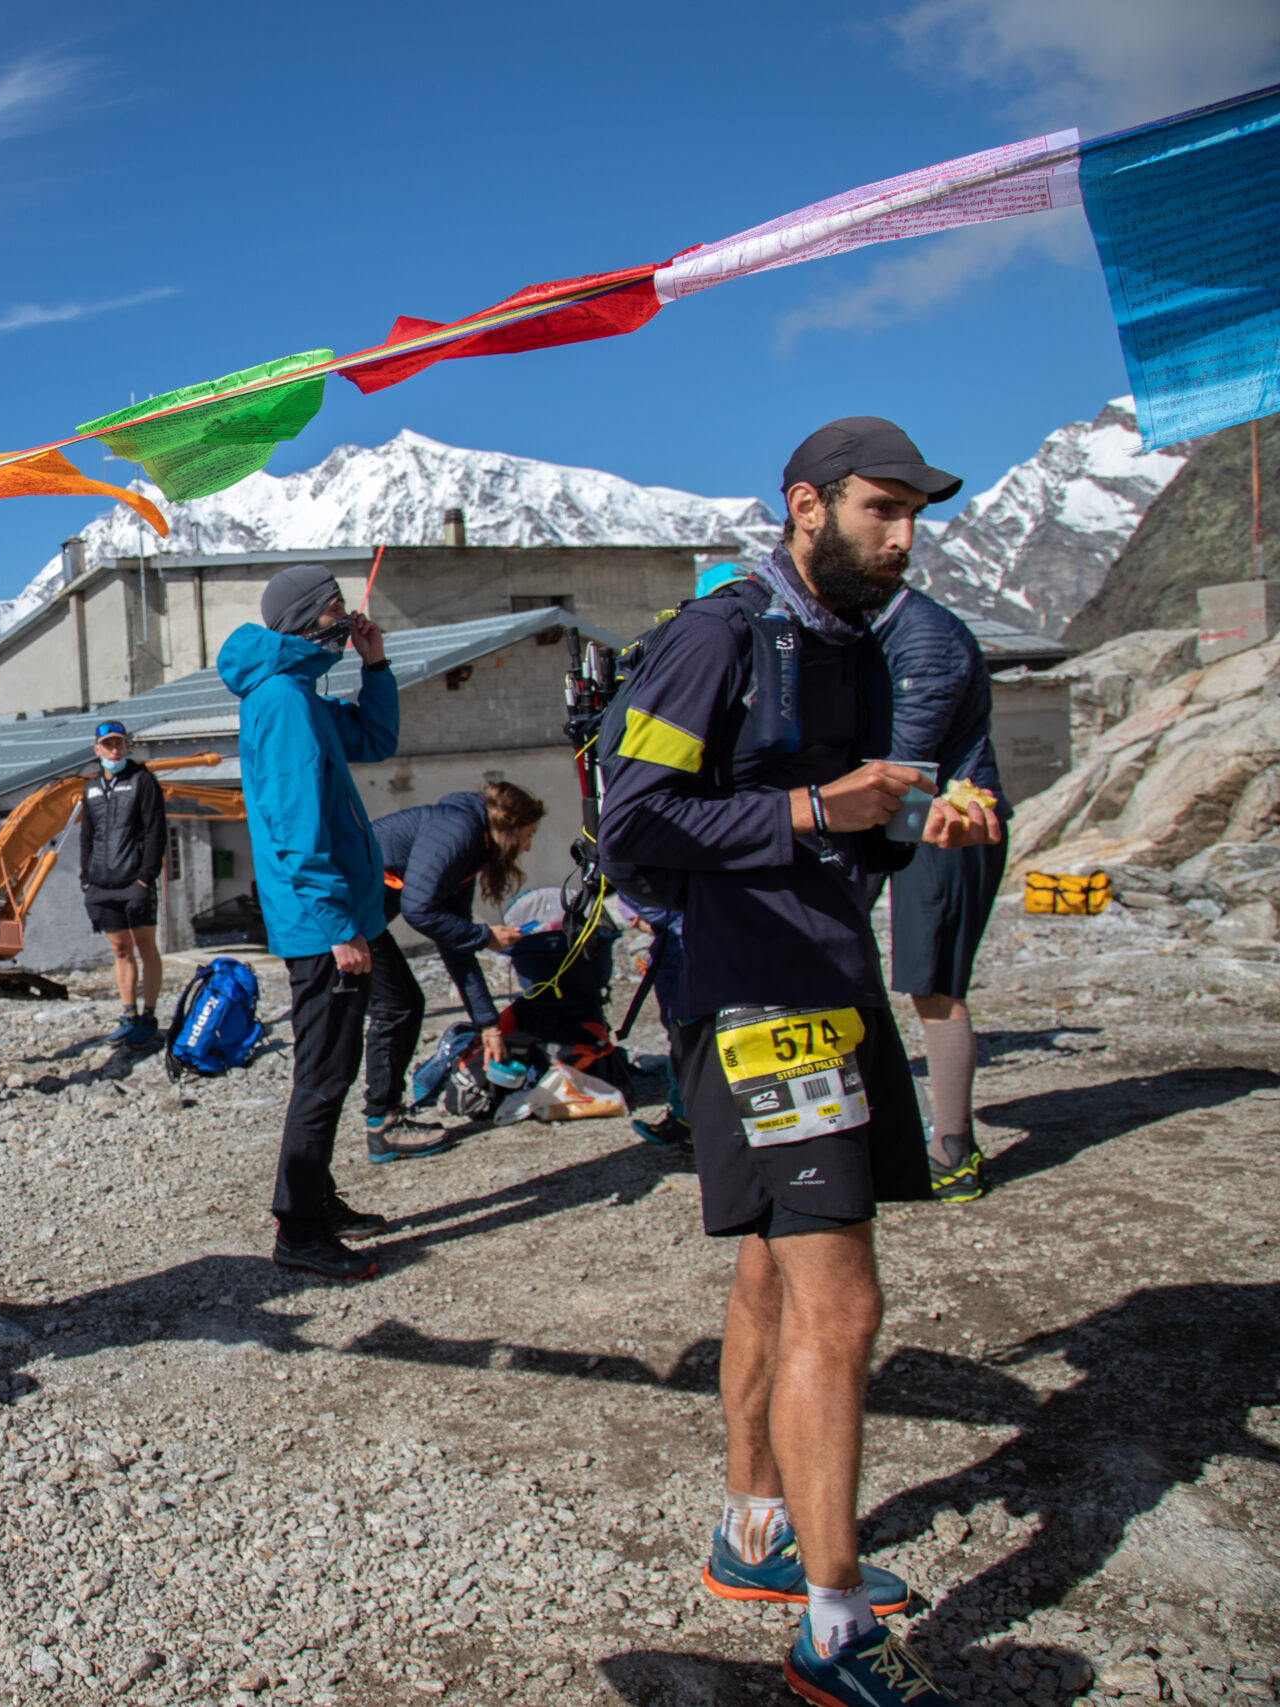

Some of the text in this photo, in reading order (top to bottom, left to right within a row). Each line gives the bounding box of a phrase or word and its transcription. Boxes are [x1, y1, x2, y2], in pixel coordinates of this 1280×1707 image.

[187, 996, 220, 1048] Kappa
[723, 1046, 738, 1068] 60K
[771, 1019, 841, 1063] 574
[776, 1064, 814, 1081] STEFANO
